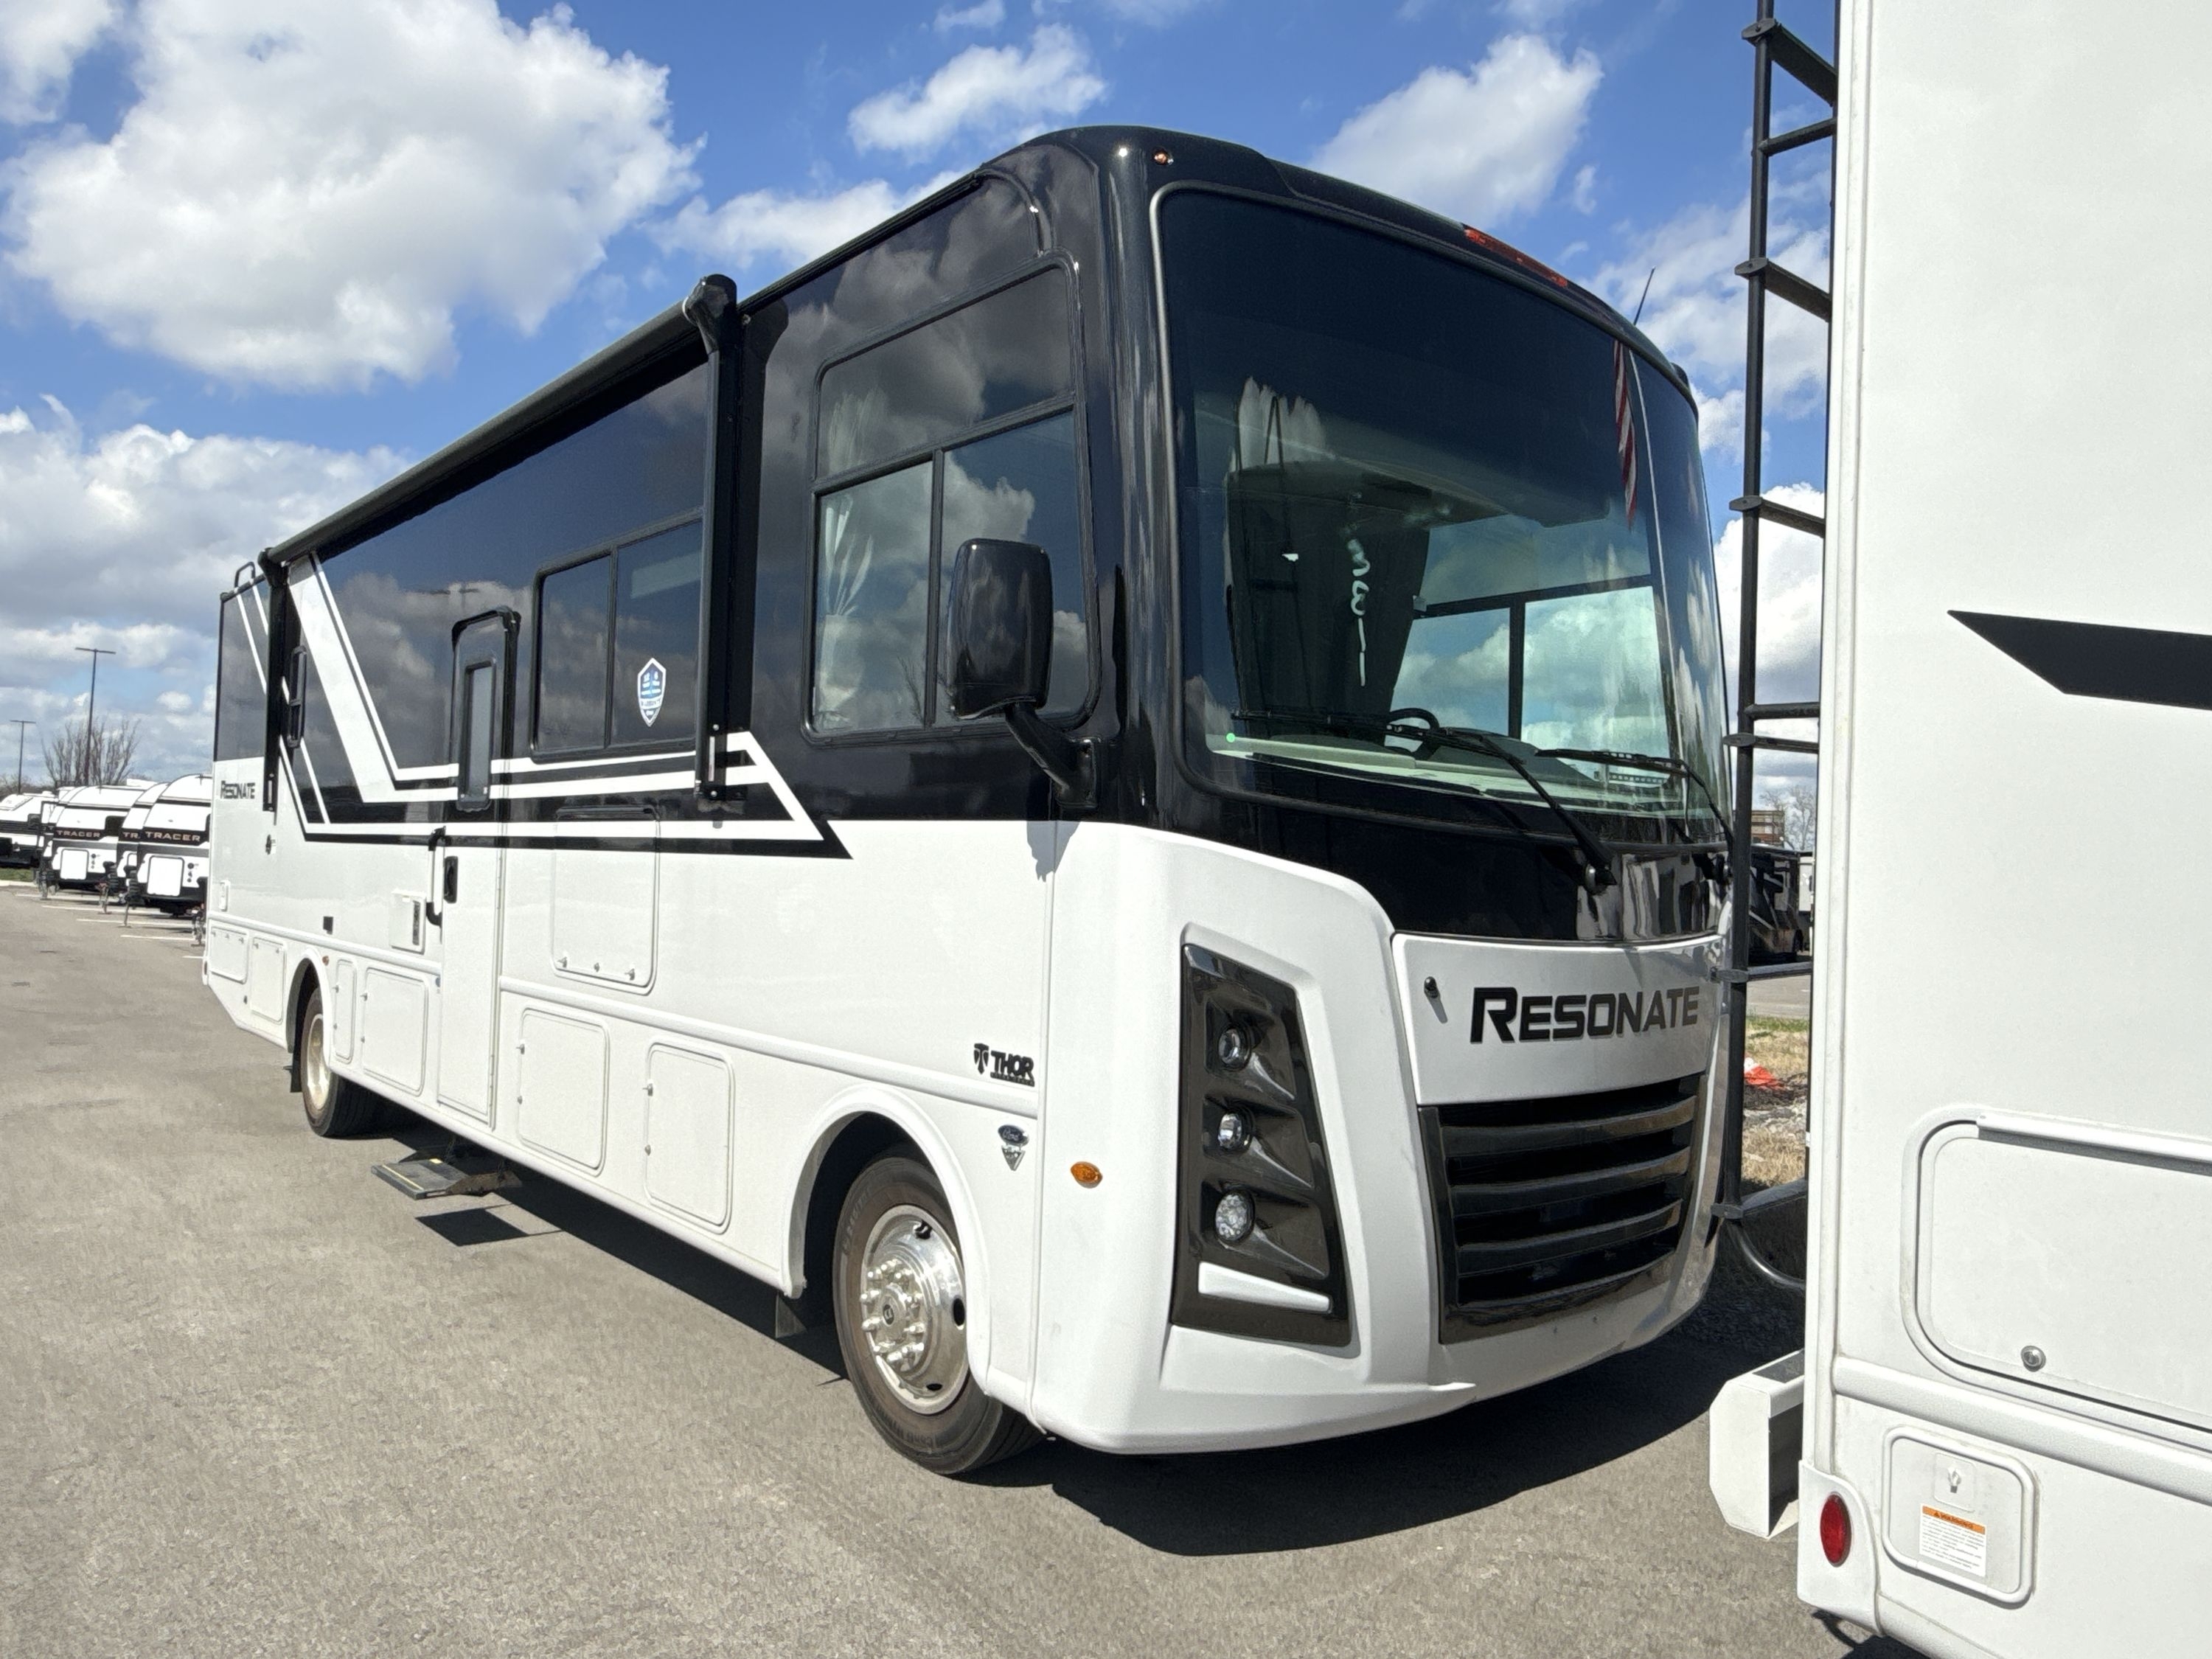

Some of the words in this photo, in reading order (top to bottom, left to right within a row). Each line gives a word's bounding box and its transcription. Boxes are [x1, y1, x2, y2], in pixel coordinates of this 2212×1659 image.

[56, 830, 101, 838] TRACER
[145, 830, 201, 841] TRACER
[1470, 986, 1700, 1044] RESONATE
[990, 1050, 1034, 1082] THOR
